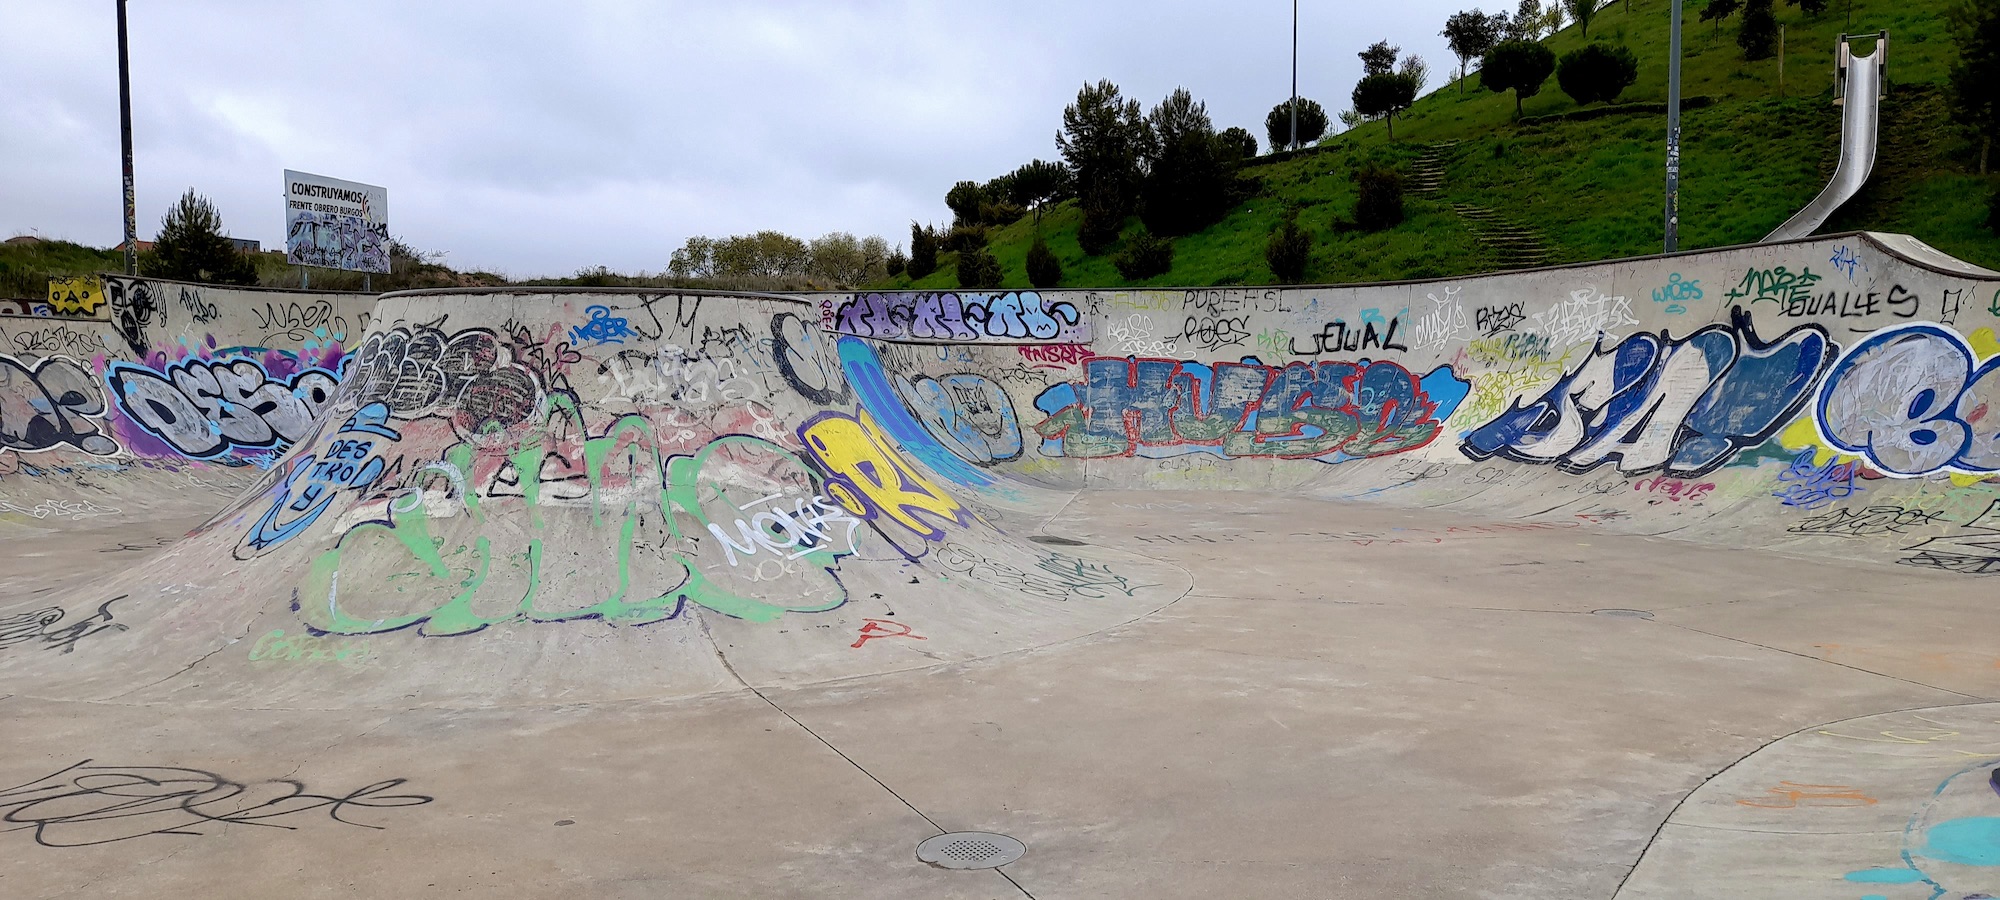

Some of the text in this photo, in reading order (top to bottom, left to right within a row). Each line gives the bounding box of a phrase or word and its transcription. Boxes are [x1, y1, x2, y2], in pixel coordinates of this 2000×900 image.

[291, 182, 362, 204] CONSTRUYAMOS
[289, 200, 363, 218] FRENTE OBRERO BURGOS
[323, 439, 373, 461] DES
